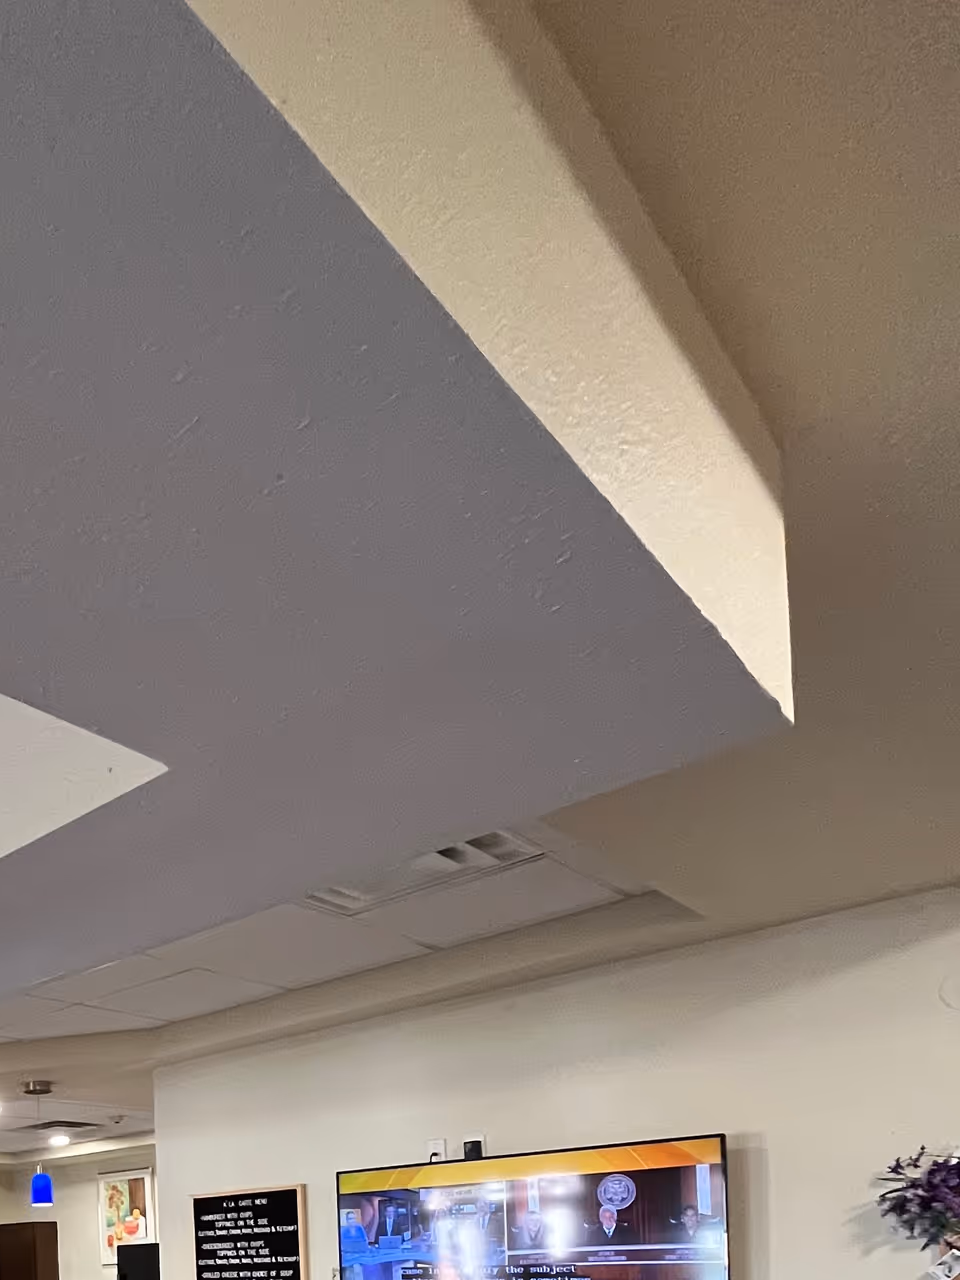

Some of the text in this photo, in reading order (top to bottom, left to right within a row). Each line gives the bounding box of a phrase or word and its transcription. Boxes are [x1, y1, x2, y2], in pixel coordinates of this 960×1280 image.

[401, 1267, 424, 1275] case
[505, 1264, 524, 1274] the
[530, 1264, 576, 1276] subject
